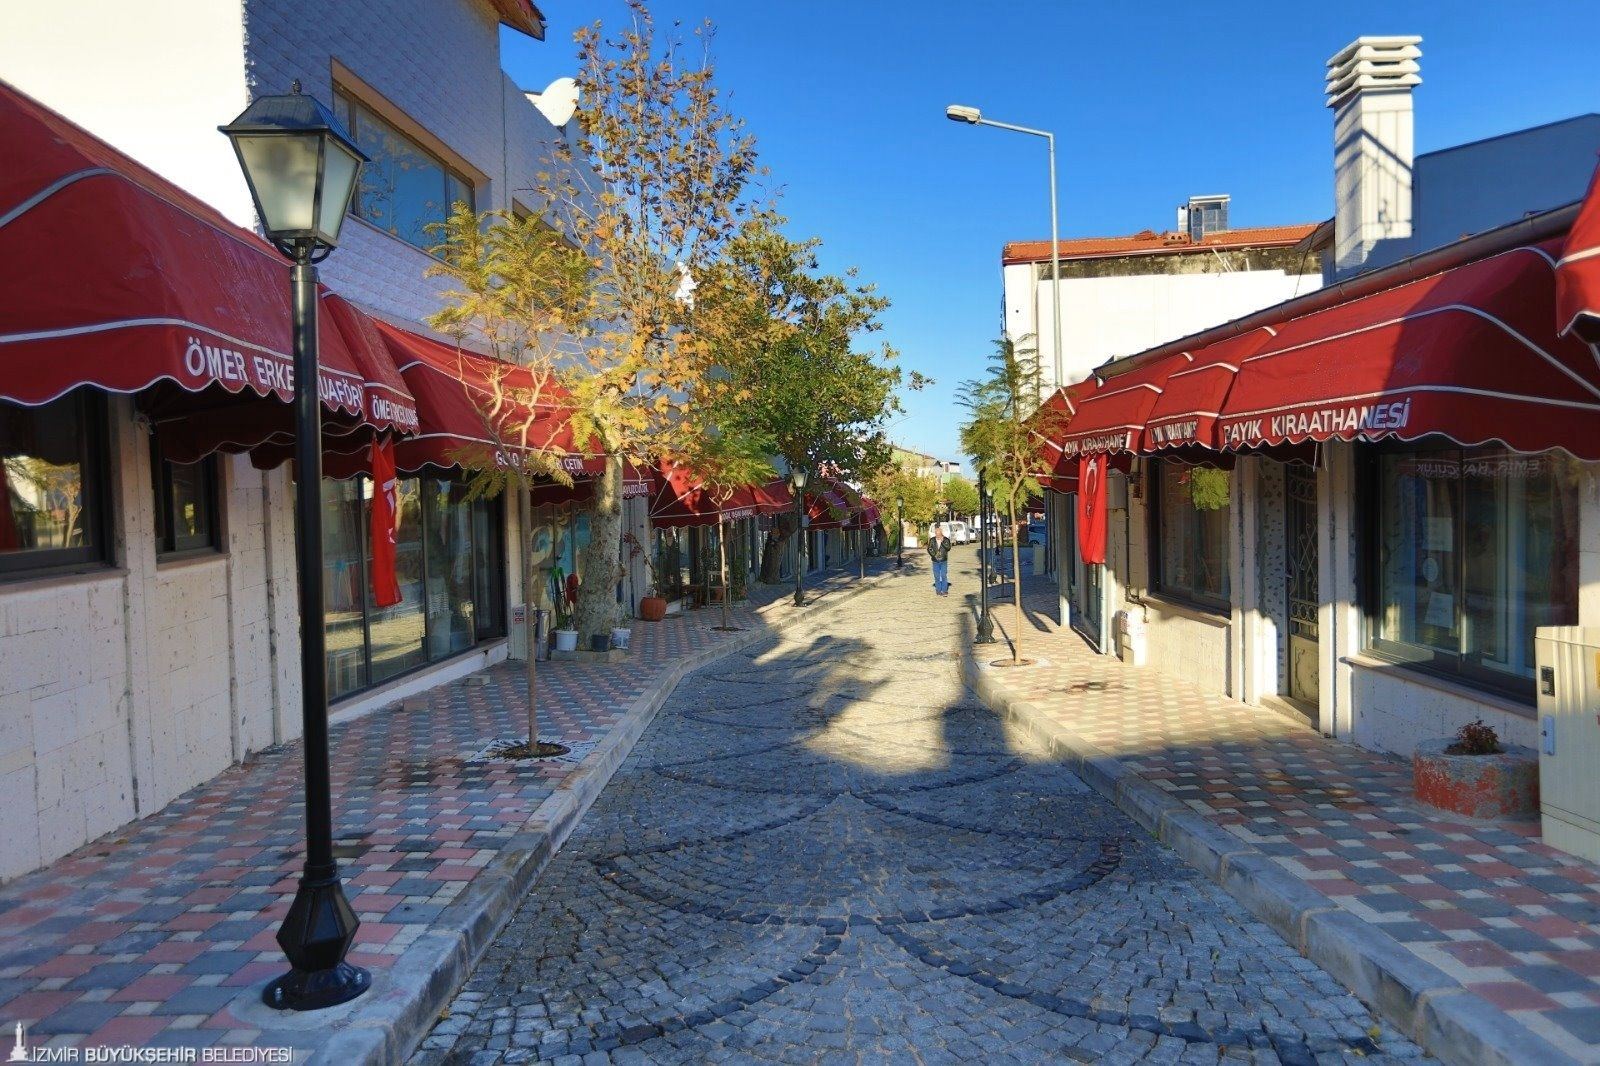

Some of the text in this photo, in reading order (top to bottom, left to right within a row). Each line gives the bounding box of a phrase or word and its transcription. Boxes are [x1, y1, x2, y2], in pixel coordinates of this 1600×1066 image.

[186, 336, 248, 382] ÖMER
[253, 356, 295, 391] ERKE
[1271, 397, 1412, 437] KIRAATHANESİ
